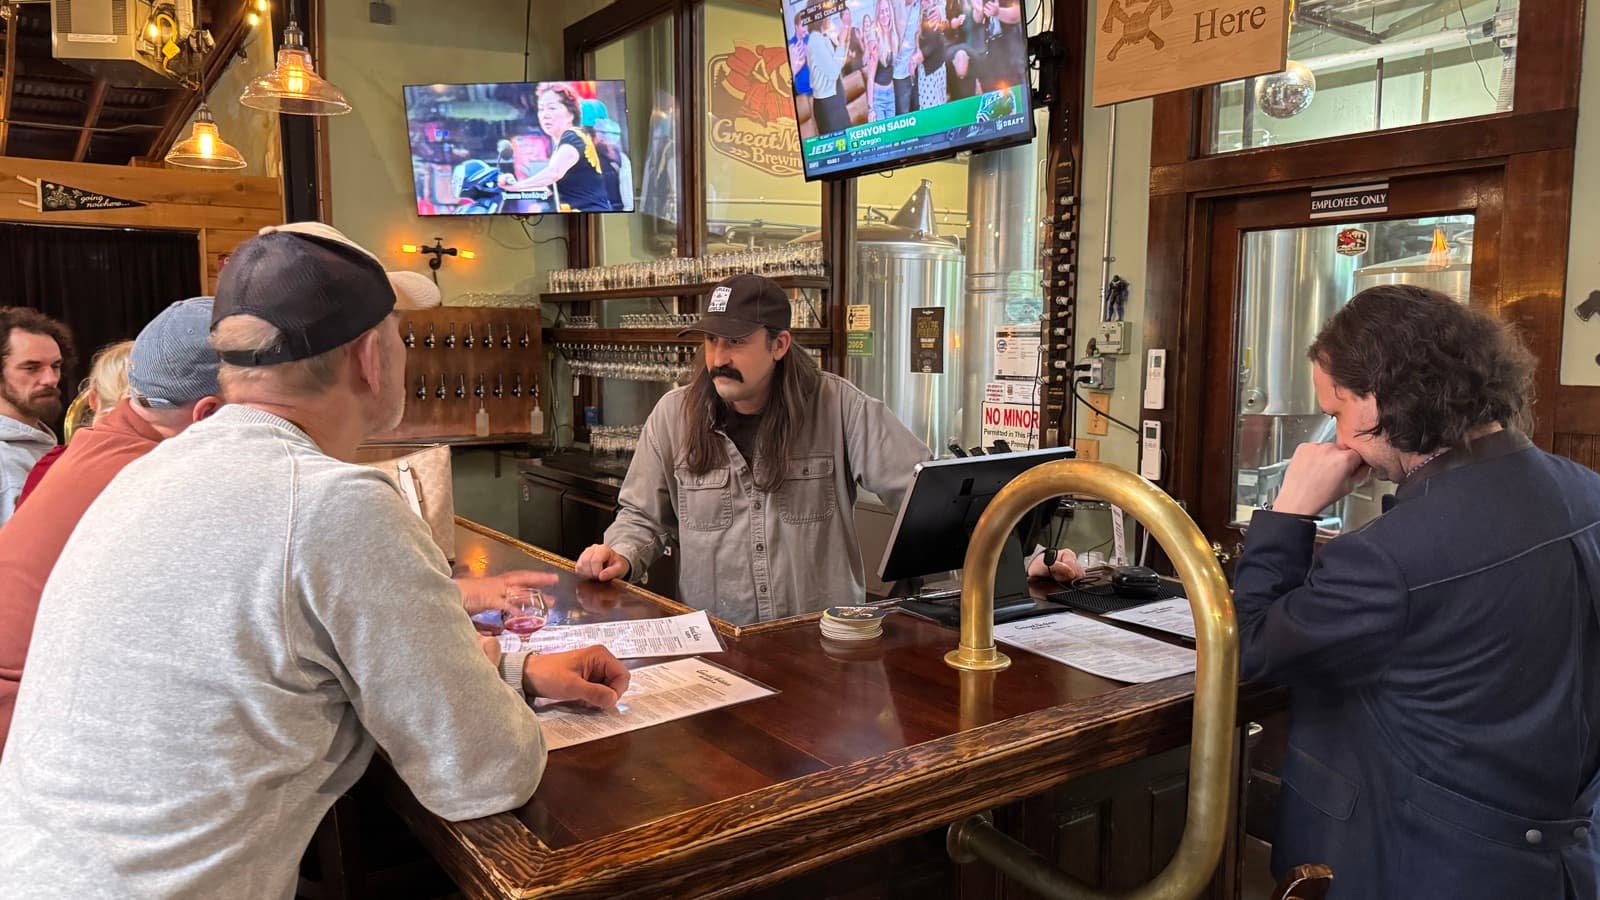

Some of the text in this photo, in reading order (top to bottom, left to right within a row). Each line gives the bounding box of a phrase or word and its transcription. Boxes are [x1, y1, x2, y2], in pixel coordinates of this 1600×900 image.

[1192, 5, 1267, 44] Here
[849, 126, 887, 140] KENYON
[887, 116, 917, 132] SADIQ
[1003, 116, 1025, 127] DRAFT
[713, 118, 781, 149] Great
[860, 137, 882, 147] Oregon
[751, 146, 804, 168] Brewin
[808, 141, 835, 156] JETS
[80, 194, 104, 204] going
[1311, 193, 1387, 210] EMPLOYEES ONLY
[985, 407, 1040, 429] NO MINOR
[984, 428, 1008, 437] Permitted
[1015, 431, 1026, 439] This
